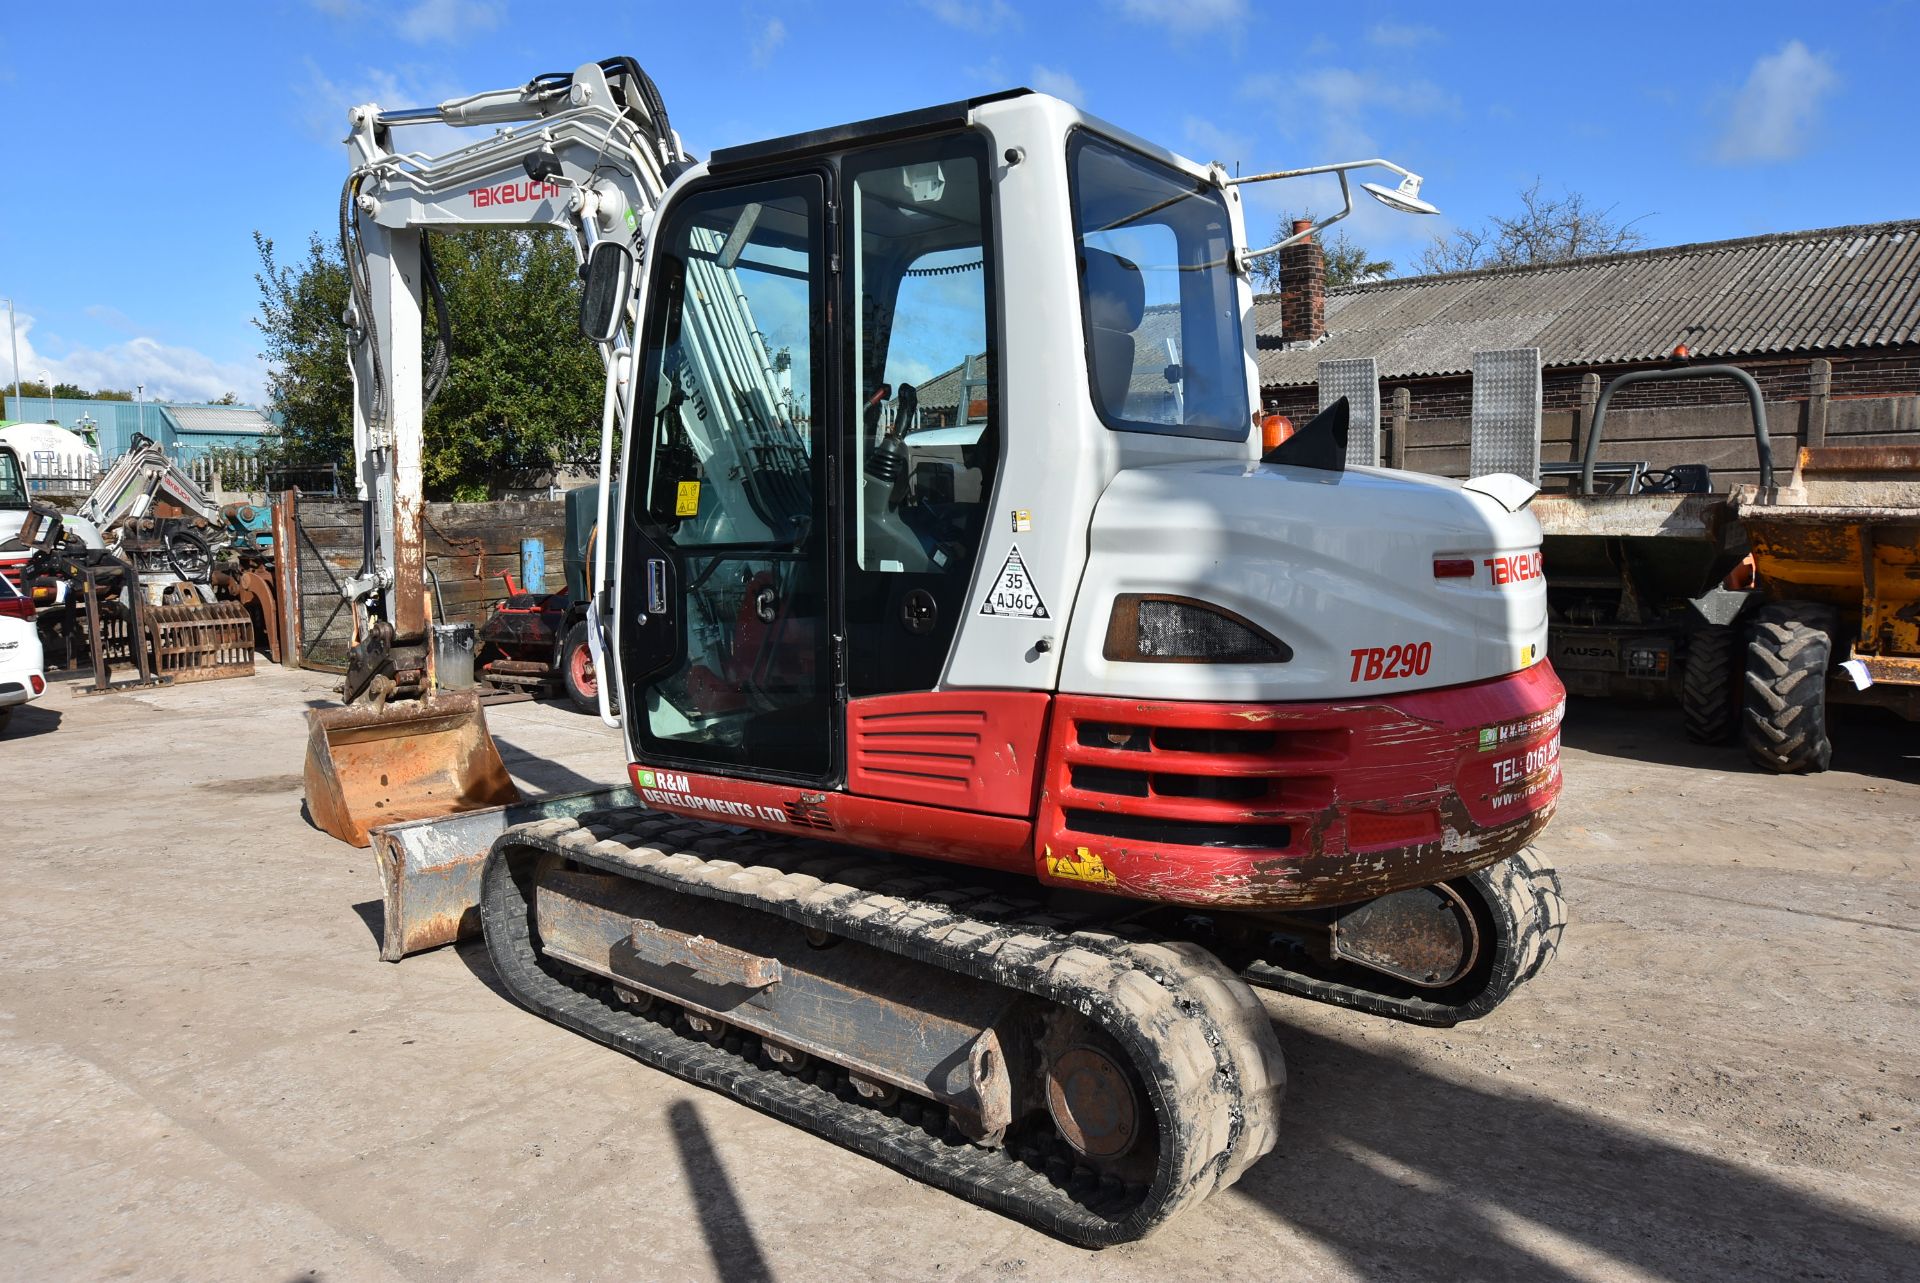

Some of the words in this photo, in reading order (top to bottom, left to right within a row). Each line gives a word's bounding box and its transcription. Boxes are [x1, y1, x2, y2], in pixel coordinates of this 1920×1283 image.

[468, 180, 559, 208] TAKEUCHI
[690, 389, 708, 421] LTD
[1005, 573, 1023, 589] 35
[1483, 552, 1543, 585] TAKEUC
[996, 592, 1034, 610] AJ6C
[1350, 641, 1432, 682] TB290
[1563, 647, 1616, 658] AUSA
[1493, 757, 1523, 784] TEL:
[1526, 746, 1548, 773] 0161
[656, 772, 691, 793] R&M
[642, 788, 756, 818] DEVELOPMENTS
[756, 805, 787, 823] LTD
